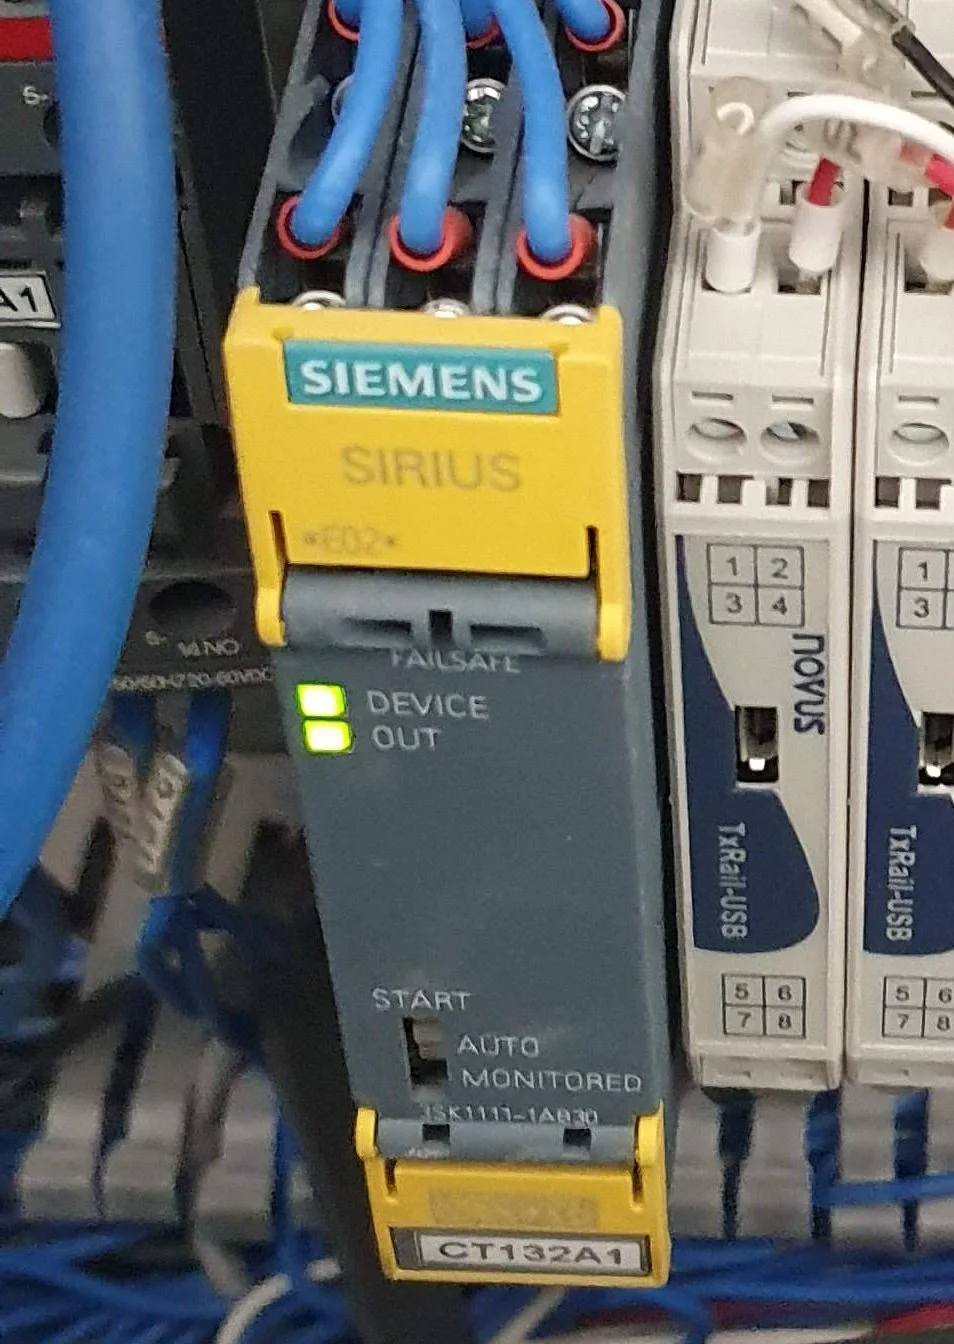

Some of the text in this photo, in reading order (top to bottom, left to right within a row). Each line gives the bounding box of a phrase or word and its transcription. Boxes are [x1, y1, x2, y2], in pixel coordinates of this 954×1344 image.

[301, 359, 543, 404] SIEMENS
[341, 446, 522, 492] SIRIUS
[726, 556, 789, 579] 1 2
[918, 561, 930, 582] 1
[725, 593, 788, 616] 3 4
[912, 596, 930, 618] 3
[366, 689, 490, 720] DEVICE
[371, 724, 442, 748] OUT
[718, 820, 749, 940] TxRail-USB
[885, 823, 917, 943] TxRail-USB
[371, 987, 474, 1012] START
[735, 982, 792, 1002] 5 6
[895, 984, 953, 1004] 5 6
[736, 1012, 792, 1030] 7 8
[896, 1013, 951, 1032] 7 8
[456, 1033, 540, 1058] AUTO
[461, 1067, 643, 1094] MONITORED
[438, 1241, 624, 1266] CT132A1
